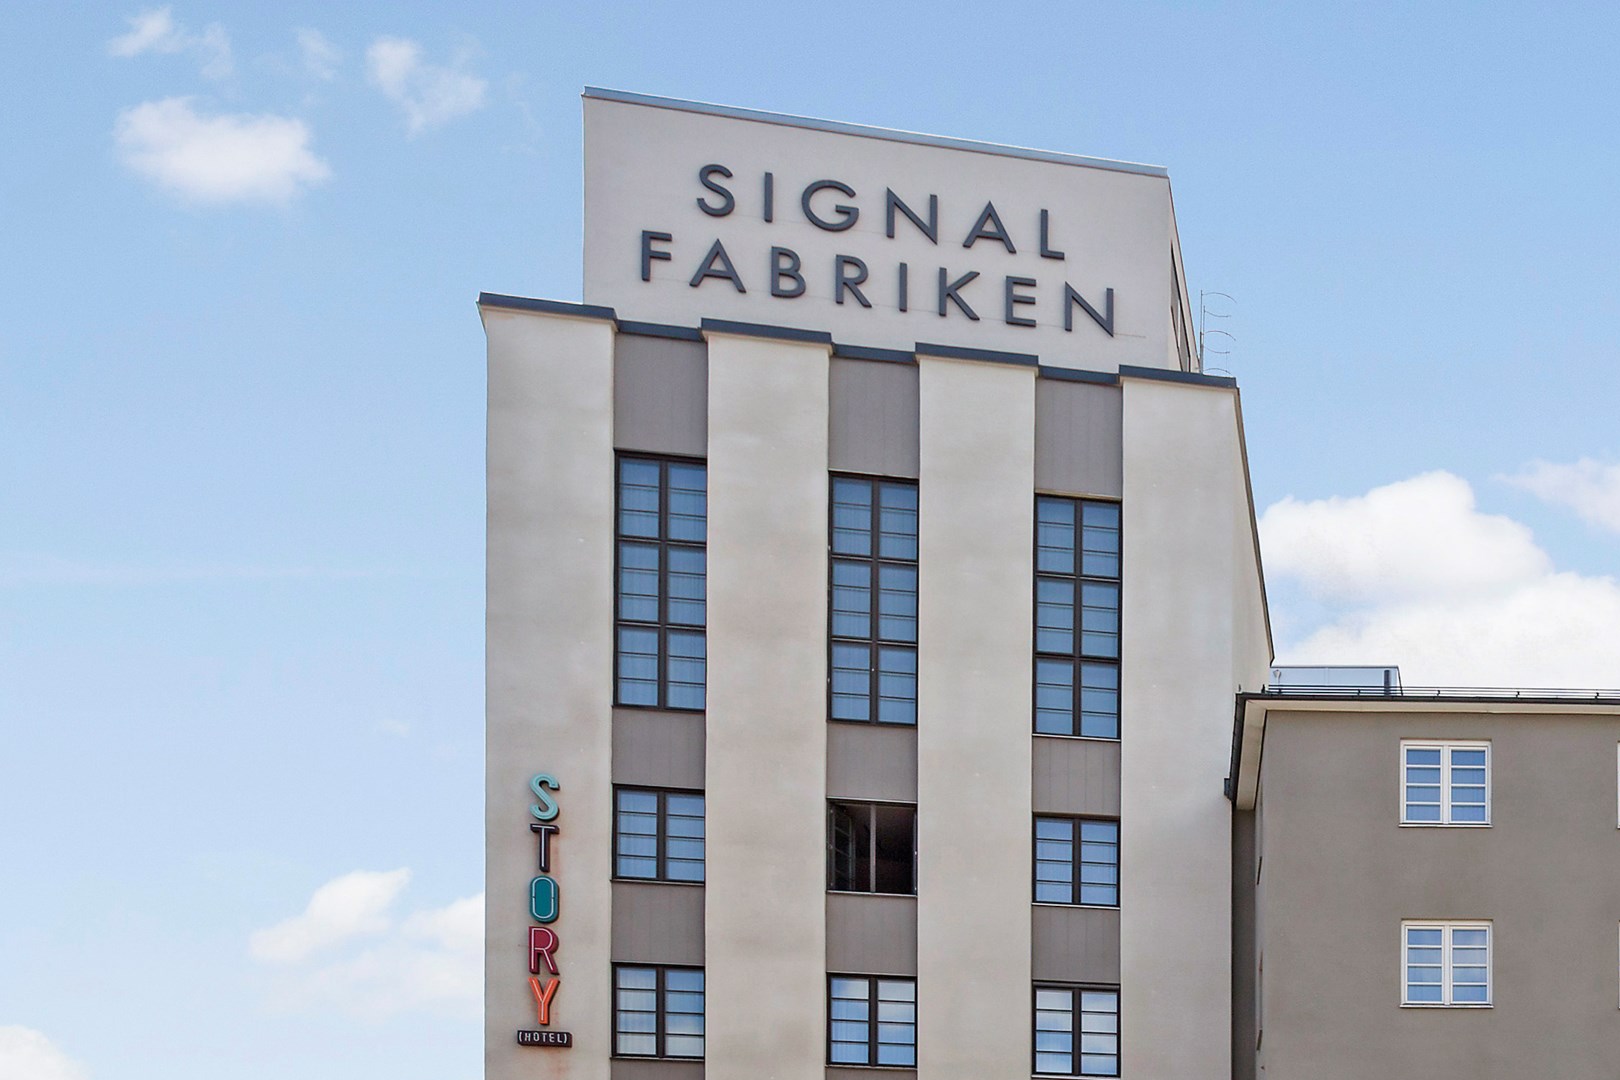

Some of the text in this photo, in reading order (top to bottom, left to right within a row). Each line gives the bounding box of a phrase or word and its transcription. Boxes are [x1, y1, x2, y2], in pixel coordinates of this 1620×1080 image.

[696, 163, 1065, 261] SIGNAL
[641, 230, 1115, 337] FABRIKEN
[528, 773, 560, 1026] STORY
